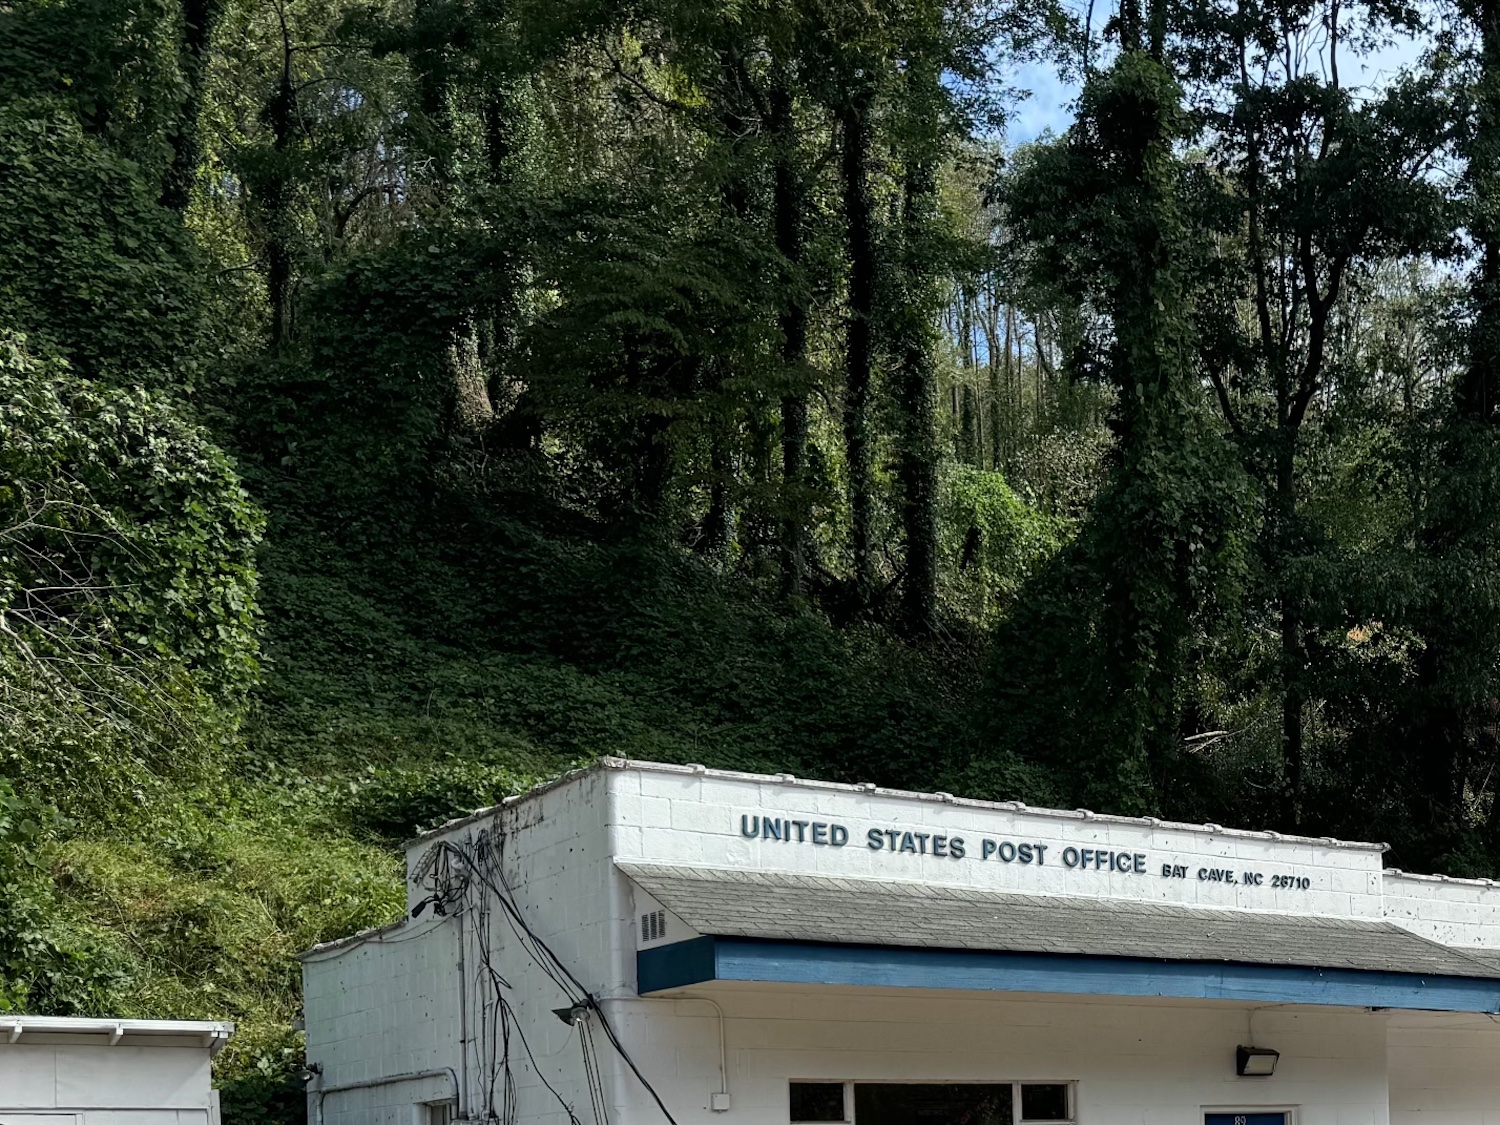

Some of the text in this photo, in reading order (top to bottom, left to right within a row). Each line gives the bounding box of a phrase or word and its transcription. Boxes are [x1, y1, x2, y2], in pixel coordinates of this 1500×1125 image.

[741, 814, 849, 847] UNITED
[867, 828, 966, 859] STATES
[982, 838, 1048, 866] POST
[1062, 846, 1147, 873] OFFICE
[1162, 863, 1188, 878] BAT
[1197, 868, 1238, 885] CAVE,
[1244, 872, 1263, 886] NC
